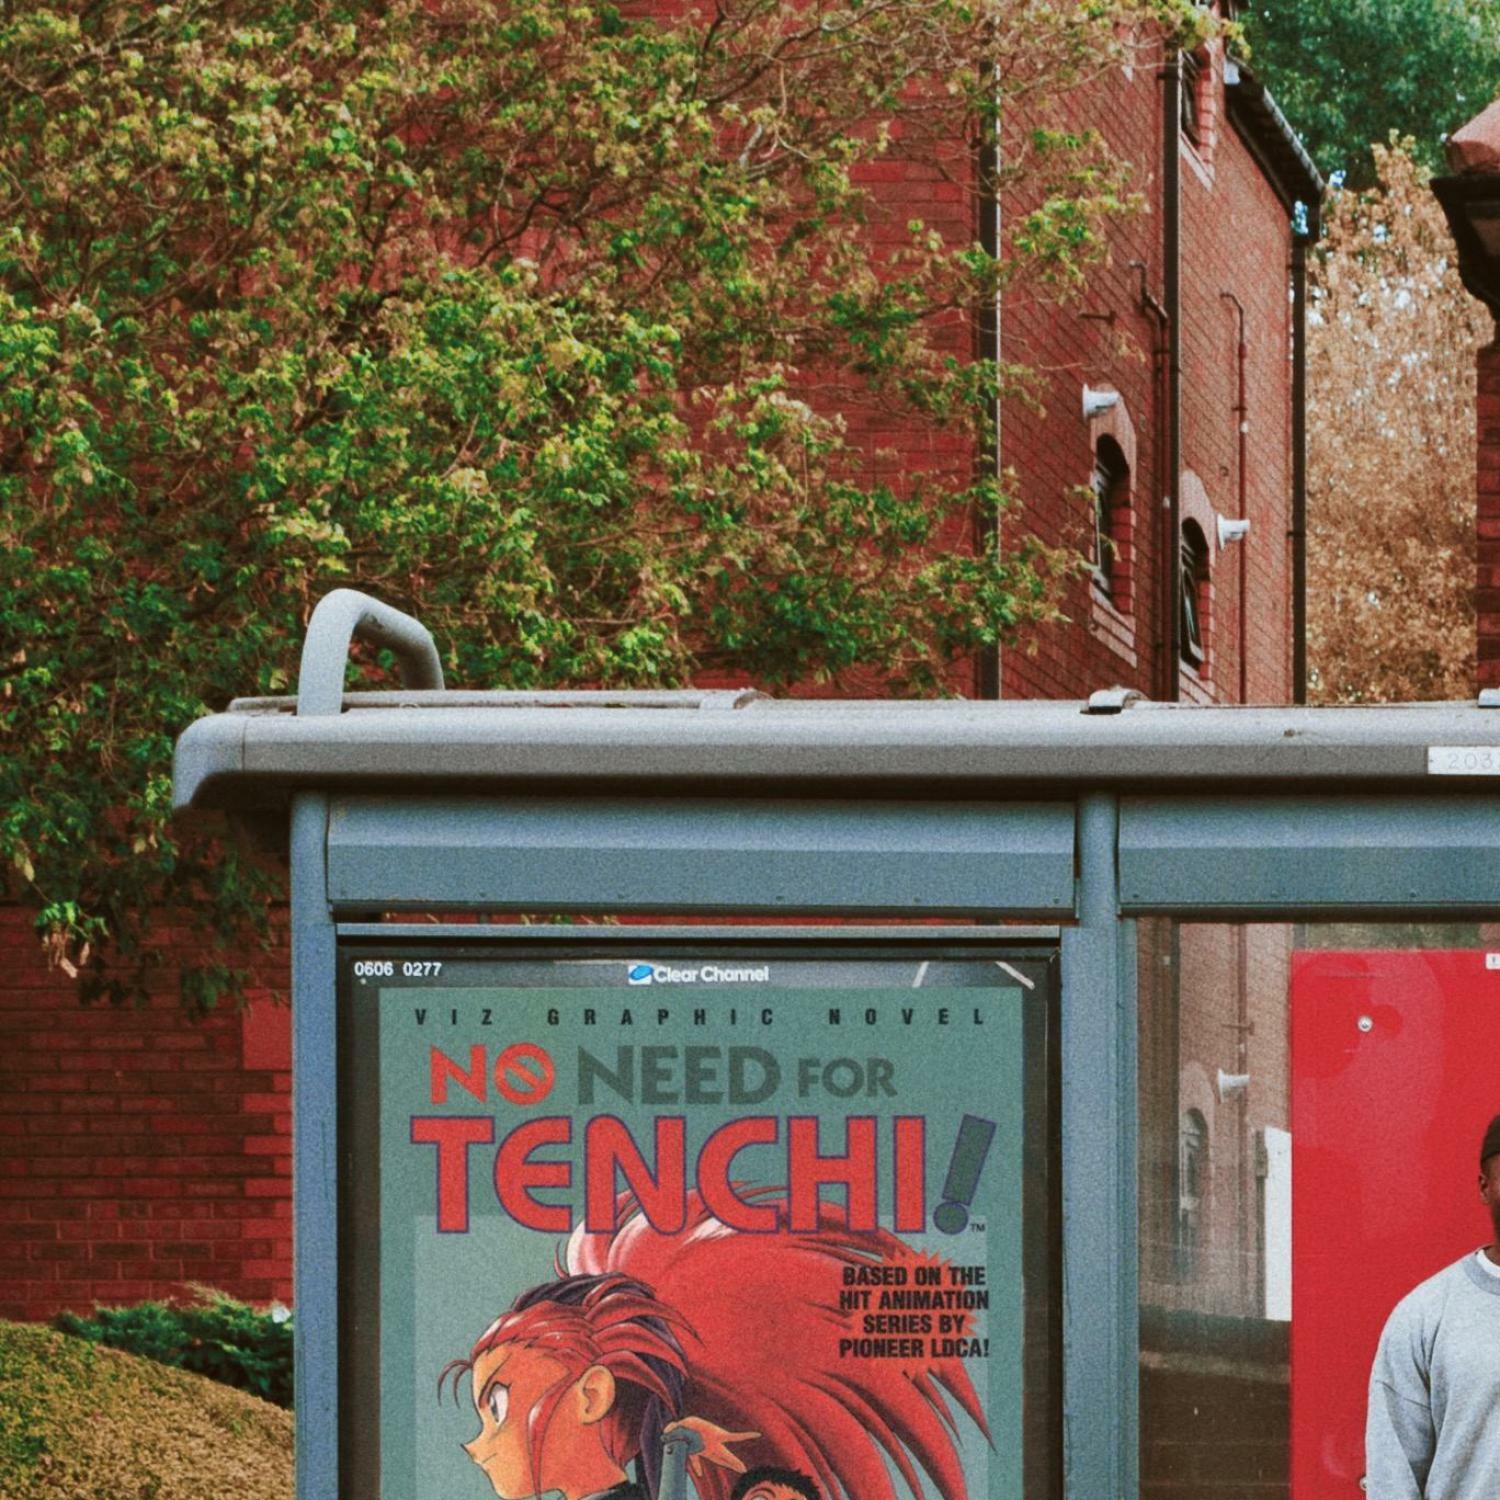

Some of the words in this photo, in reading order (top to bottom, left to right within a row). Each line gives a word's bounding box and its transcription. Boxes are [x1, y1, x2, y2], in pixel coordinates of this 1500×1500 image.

[354, 962, 394, 977] 0606
[402, 962, 443, 977] 0277
[654, 965, 698, 983] Clear
[700, 965, 770, 982] Channel
[414, 1008, 493, 1026] VIZ
[547, 1008, 773, 1026] GRAPHIC
[828, 1008, 984, 1026] NOVEL
[430, 1041, 555, 1107] NO
[577, 1044, 781, 1106] NEED
[798, 1057, 899, 1098] FOR
[409, 1112, 997, 1237] TENCHI!
[842, 1266, 907, 1286] BASED
[914, 1266, 941, 1286] ON
[948, 1266, 986, 1286] THE
[839, 1290, 872, 1310] HIT
[878, 1290, 989, 1310] ANIMATION
[863, 1314, 932, 1334] SERIES
[938, 1314, 966, 1334] BY
[839, 1338, 925, 1358] PIONEER
[930, 1338, 990, 1358] LDCA!
